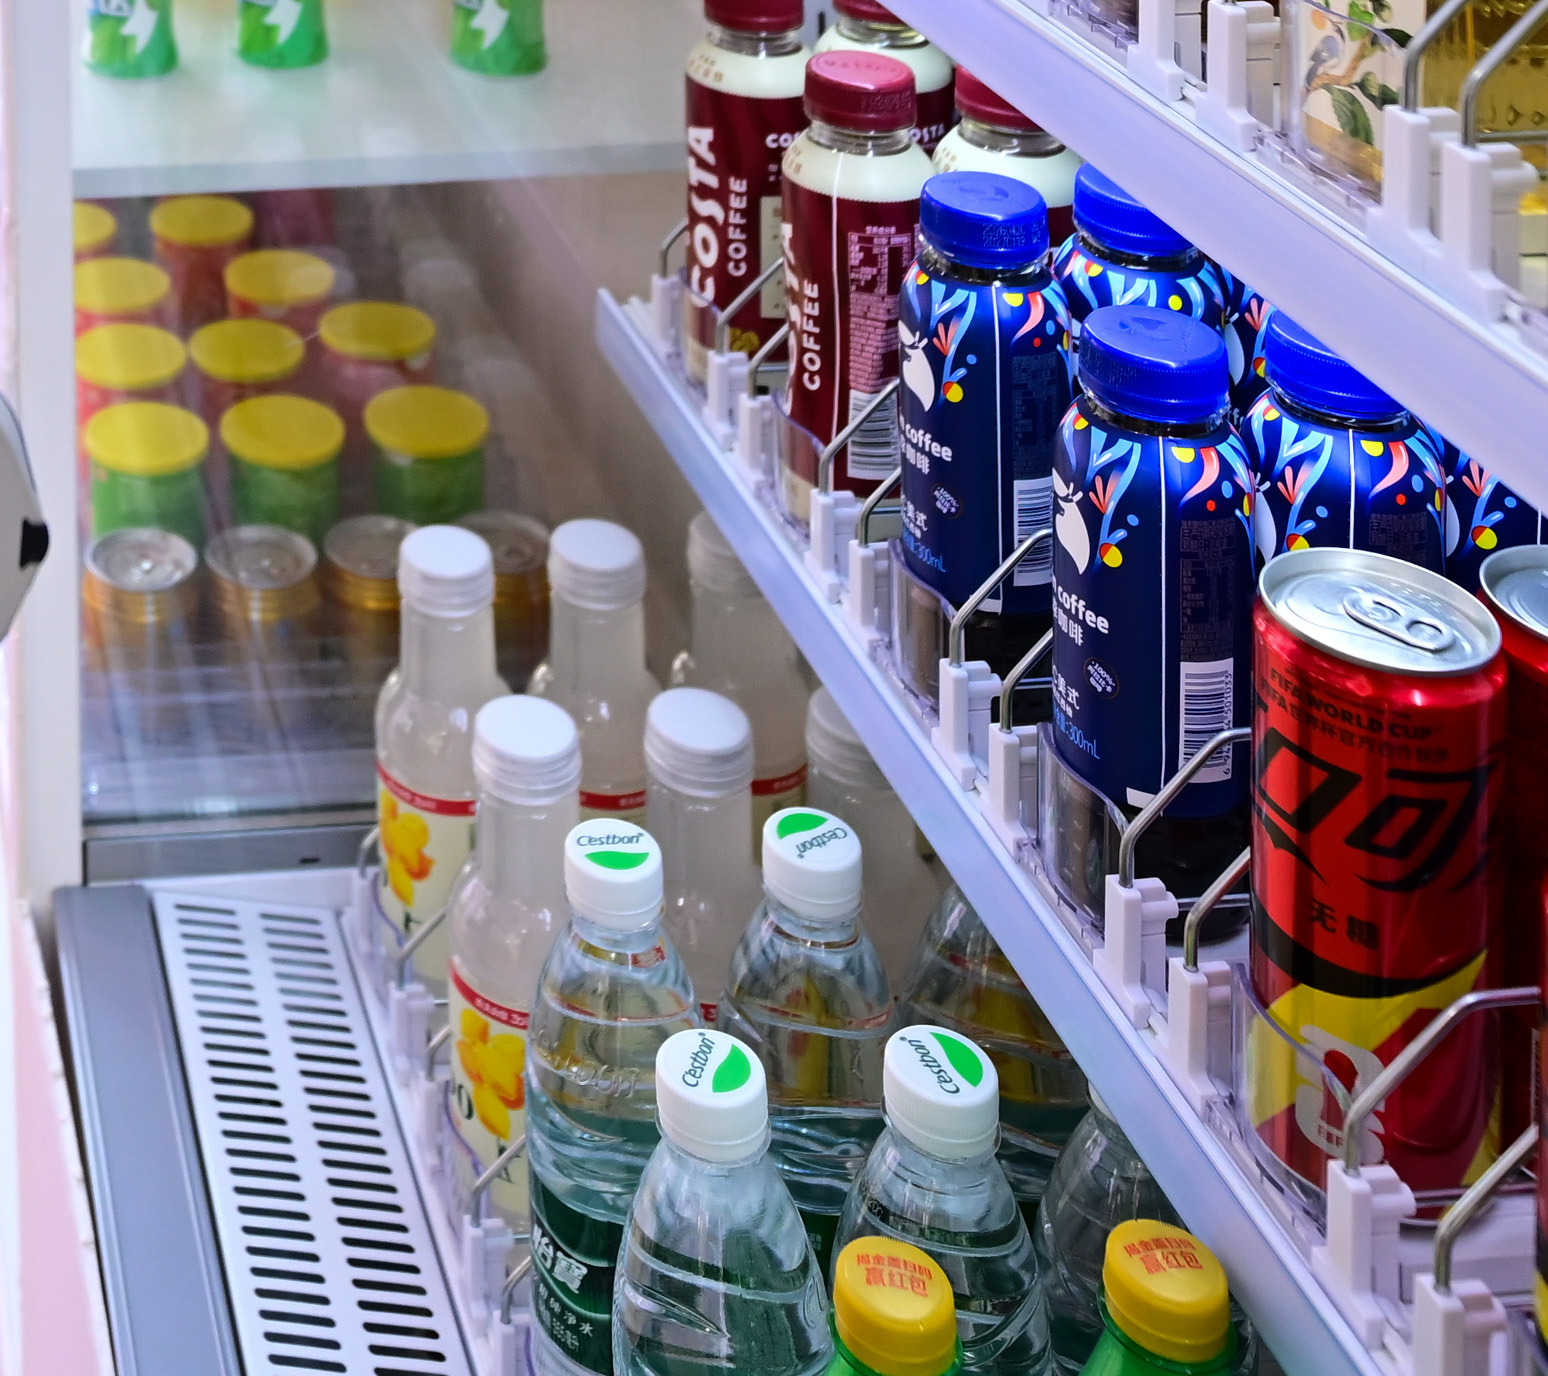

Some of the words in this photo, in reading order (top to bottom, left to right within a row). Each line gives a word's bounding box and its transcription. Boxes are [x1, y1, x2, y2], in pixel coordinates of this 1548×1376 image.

[688, 126, 725, 307] COSTA
[728, 176, 748, 277] COFFEE
[802, 279, 820, 391] COFFEE
[904, 423, 953, 462] coffee
[1057, 585, 1110, 635] coffee
[1308, 696, 1384, 734] WORLD
[1389, 722, 1432, 741] CUP
[864, 1267, 930, 1298] 赢红包
[1139, 1251, 1204, 1275] 赢红包
